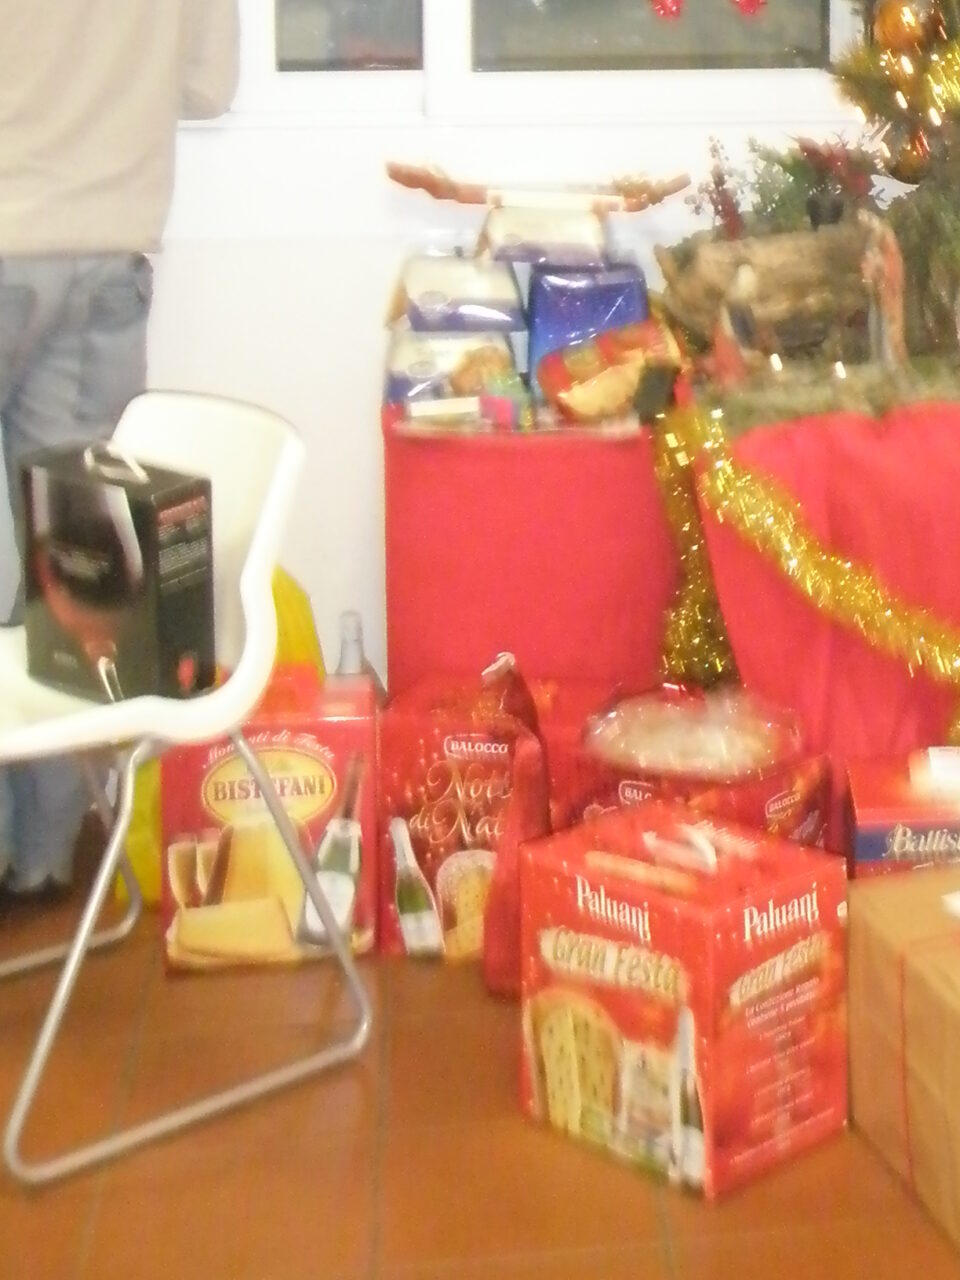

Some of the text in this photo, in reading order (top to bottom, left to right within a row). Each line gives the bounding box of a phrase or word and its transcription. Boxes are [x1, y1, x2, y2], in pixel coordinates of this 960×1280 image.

[450, 739, 510, 754] BALOCCO
[212, 773, 326, 802] BISTFANI
[575, 874, 652, 944] Paluani
[743, 881, 819, 942] Paluani
